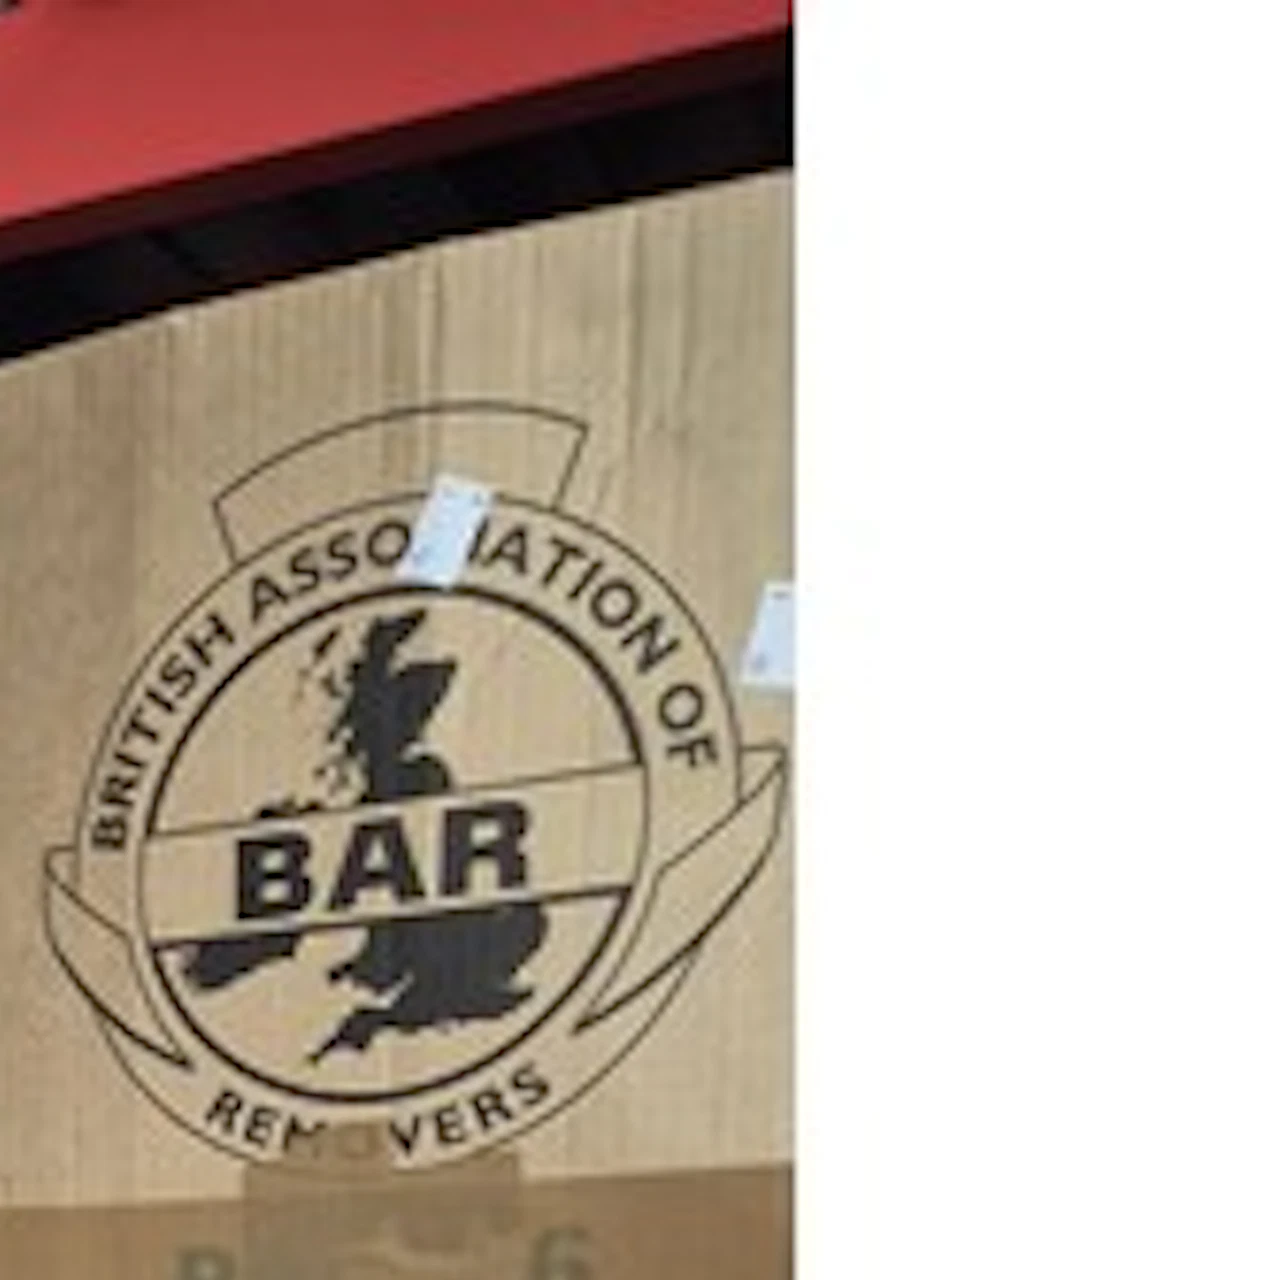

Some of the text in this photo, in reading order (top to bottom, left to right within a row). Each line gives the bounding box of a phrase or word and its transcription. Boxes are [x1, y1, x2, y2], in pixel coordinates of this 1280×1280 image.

[90, 516, 719, 852] BRITISH ASSOIATION OF
[237, 799, 532, 922] BAR
[204, 1060, 550, 1158] REMVERS
